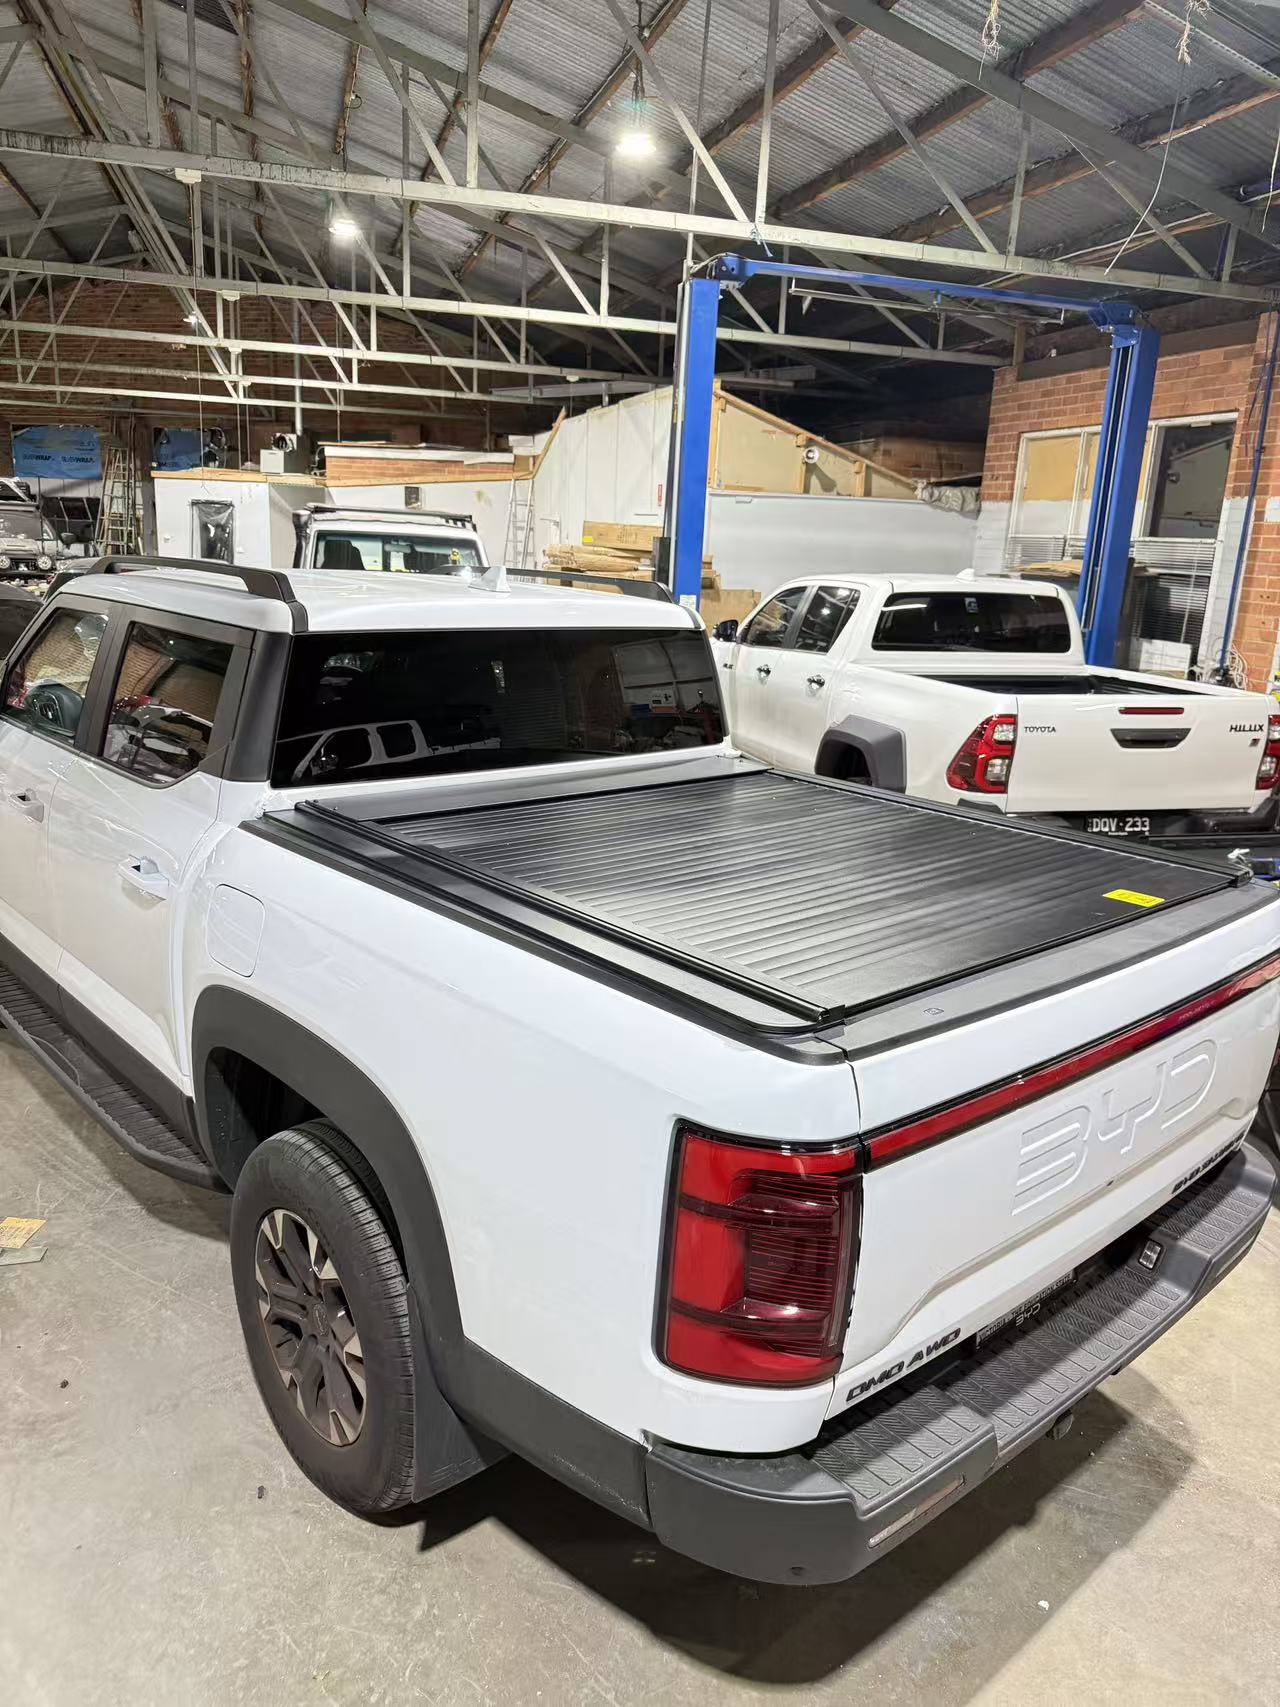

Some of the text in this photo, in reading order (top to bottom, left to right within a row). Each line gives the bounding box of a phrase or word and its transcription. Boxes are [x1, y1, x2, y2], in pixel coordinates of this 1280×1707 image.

[1229, 723, 1264, 732] HILUX
[1011, 1038, 1217, 1216] BYD
[1016, 1303, 1041, 1326] BYD
[846, 1327, 961, 1402] DMO AWD
